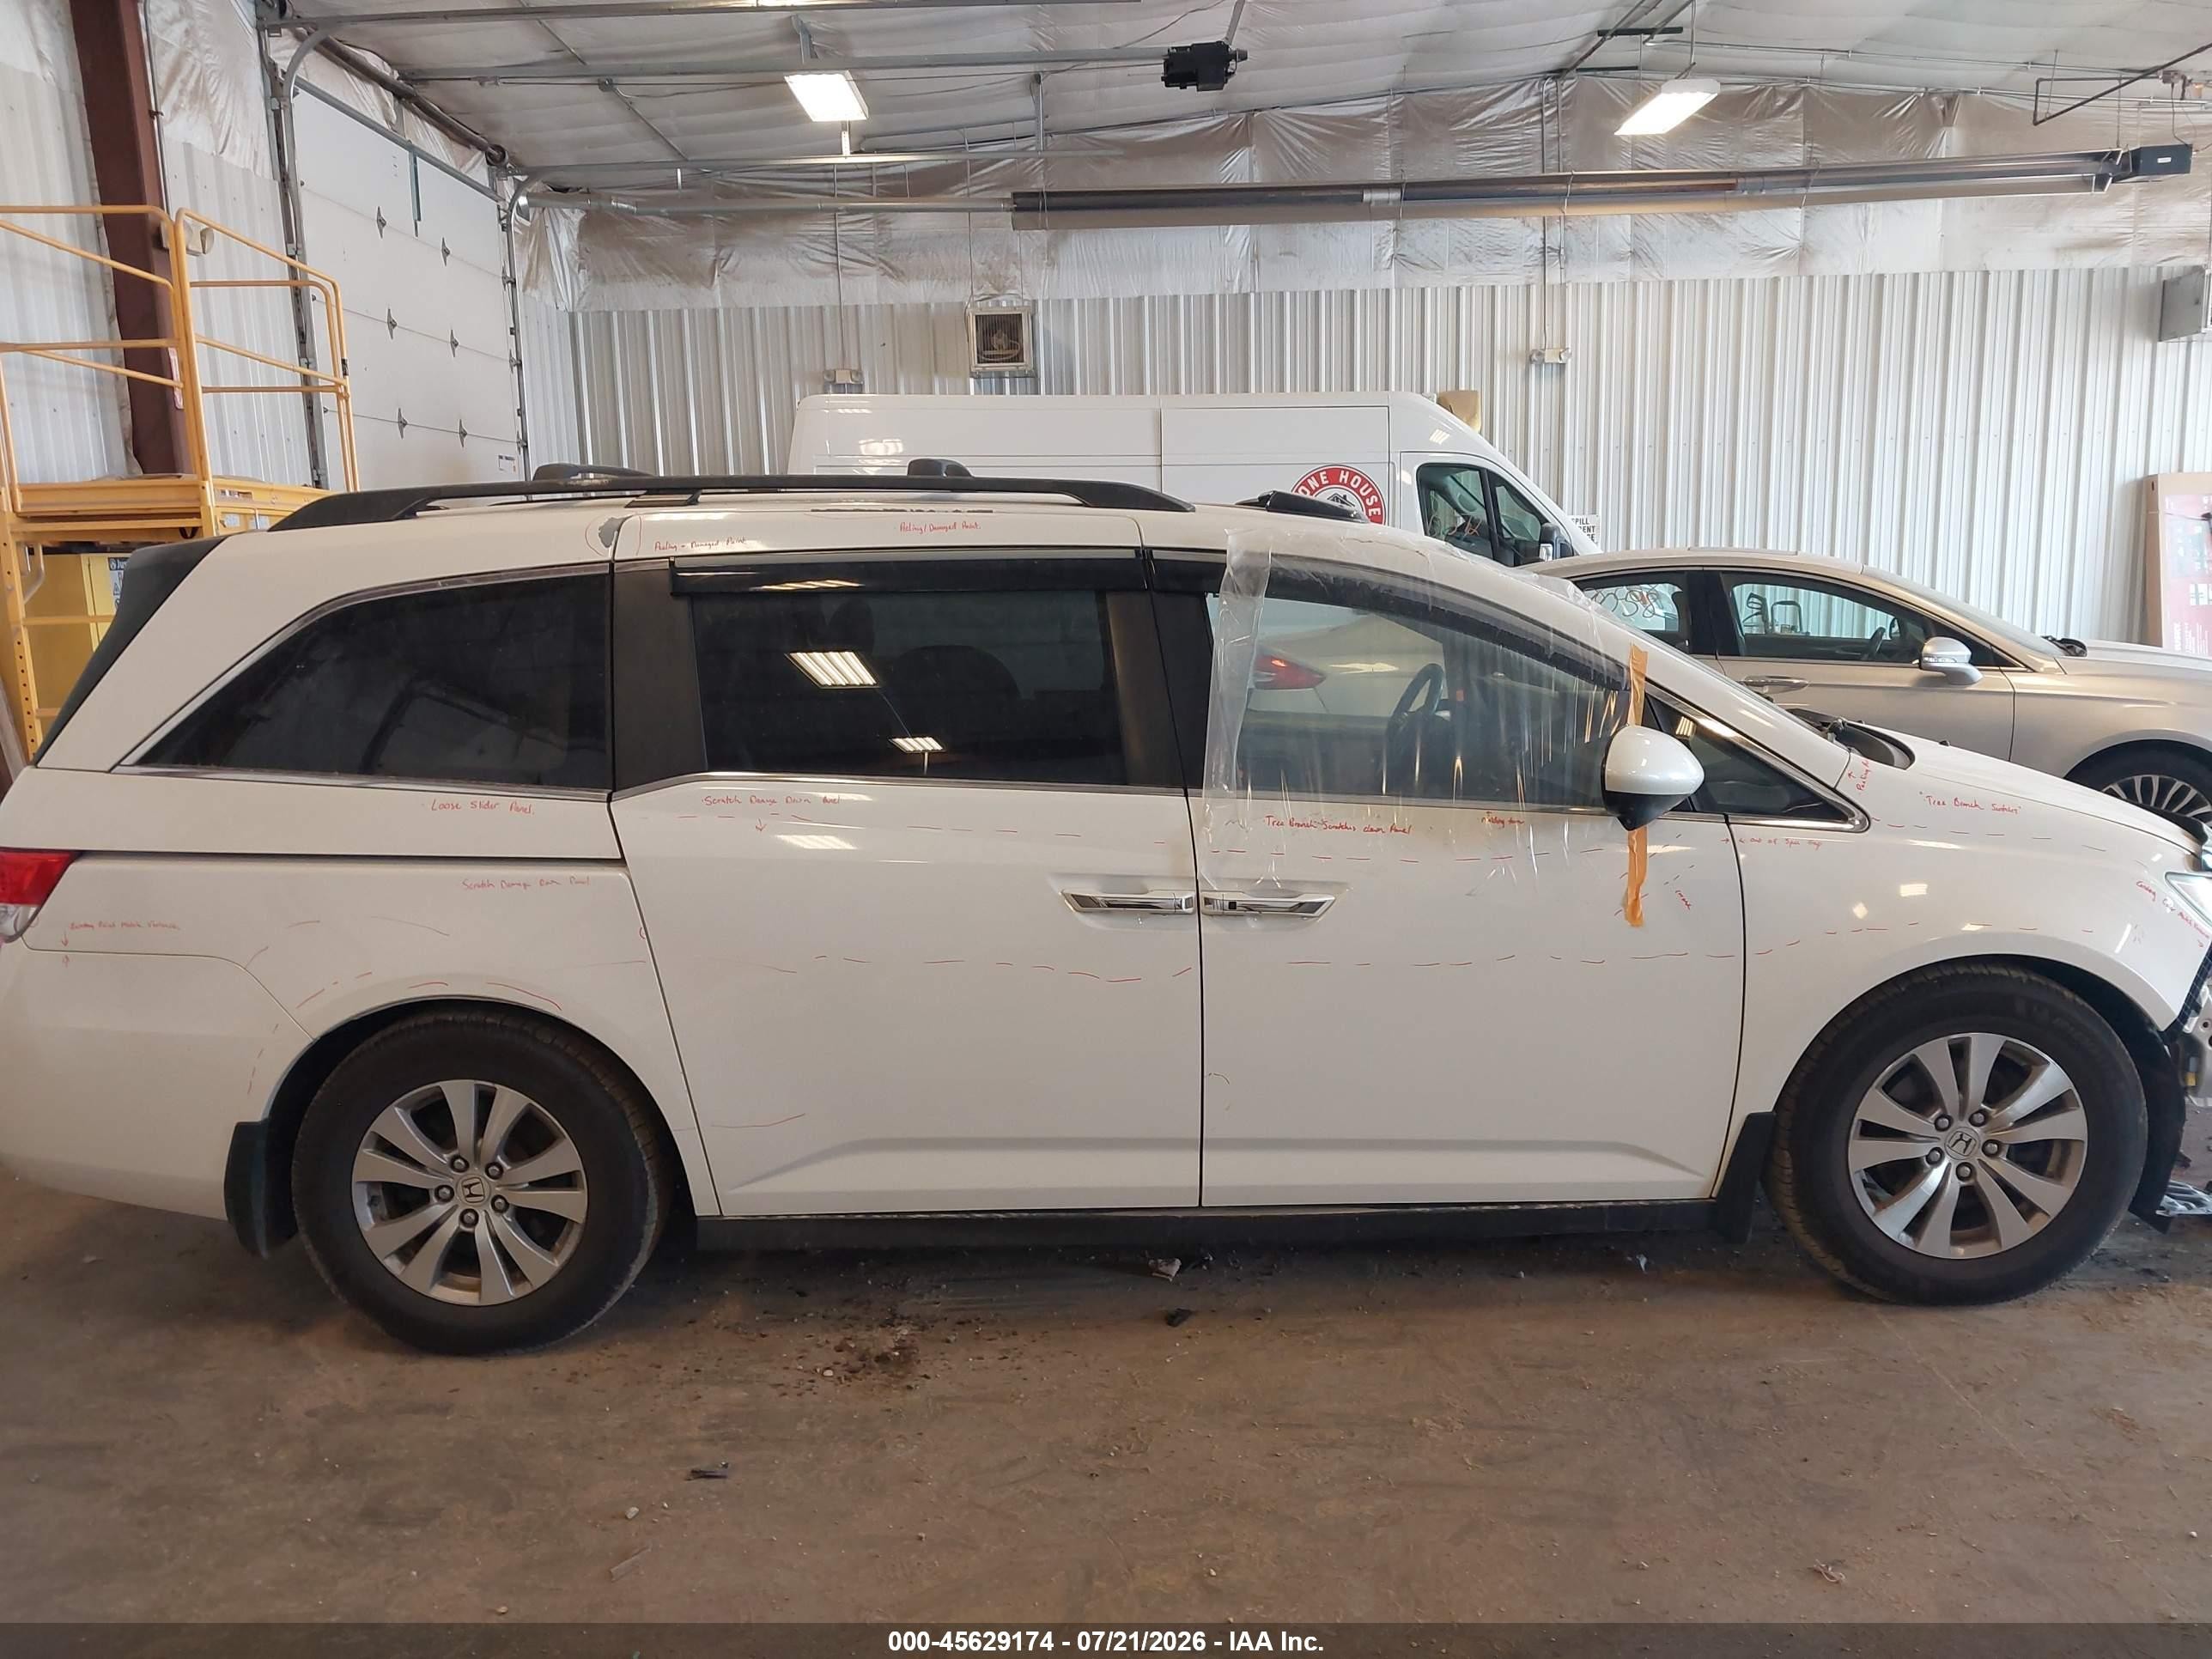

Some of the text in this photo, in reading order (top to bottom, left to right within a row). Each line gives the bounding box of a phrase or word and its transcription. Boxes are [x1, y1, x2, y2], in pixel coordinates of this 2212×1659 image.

[1340, 470, 1381, 517] HOUSE
[431, 799, 461, 811] Loose
[470, 799, 499, 810] Slider
[704, 795, 742, 806] Scratch
[1265, 815, 1285, 826] Tree
